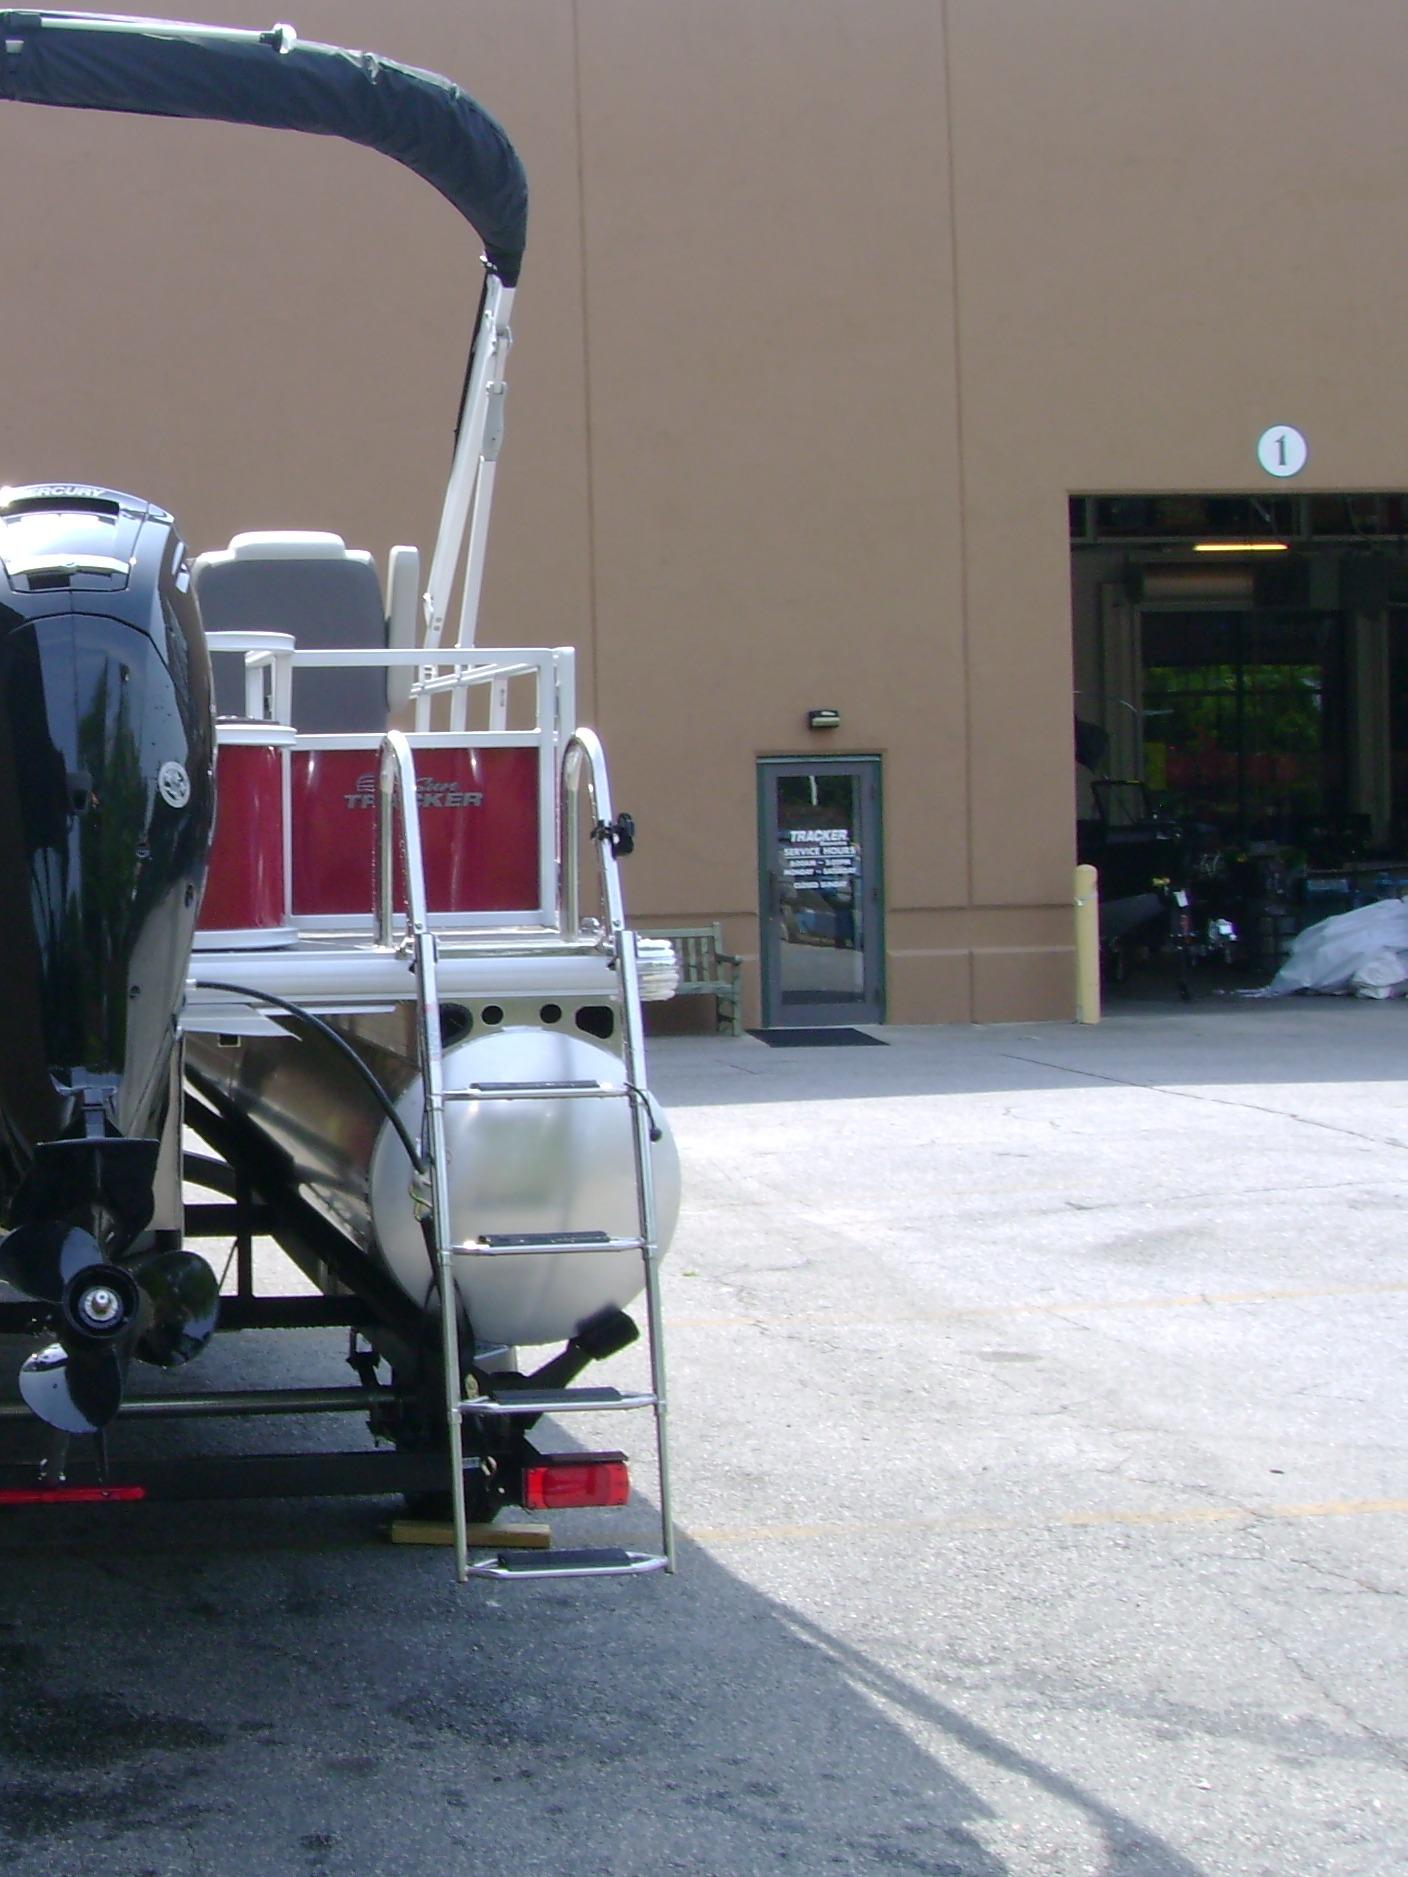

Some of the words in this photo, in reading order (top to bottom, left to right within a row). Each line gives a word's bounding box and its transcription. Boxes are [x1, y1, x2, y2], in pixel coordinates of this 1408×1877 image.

[1273, 434, 1287, 466] 1
[344, 792, 483, 808] TRKER
[790, 829, 848, 842] TRACKER
[783, 847, 820, 856] SERVICE
[823, 846, 856, 855] HOURS
